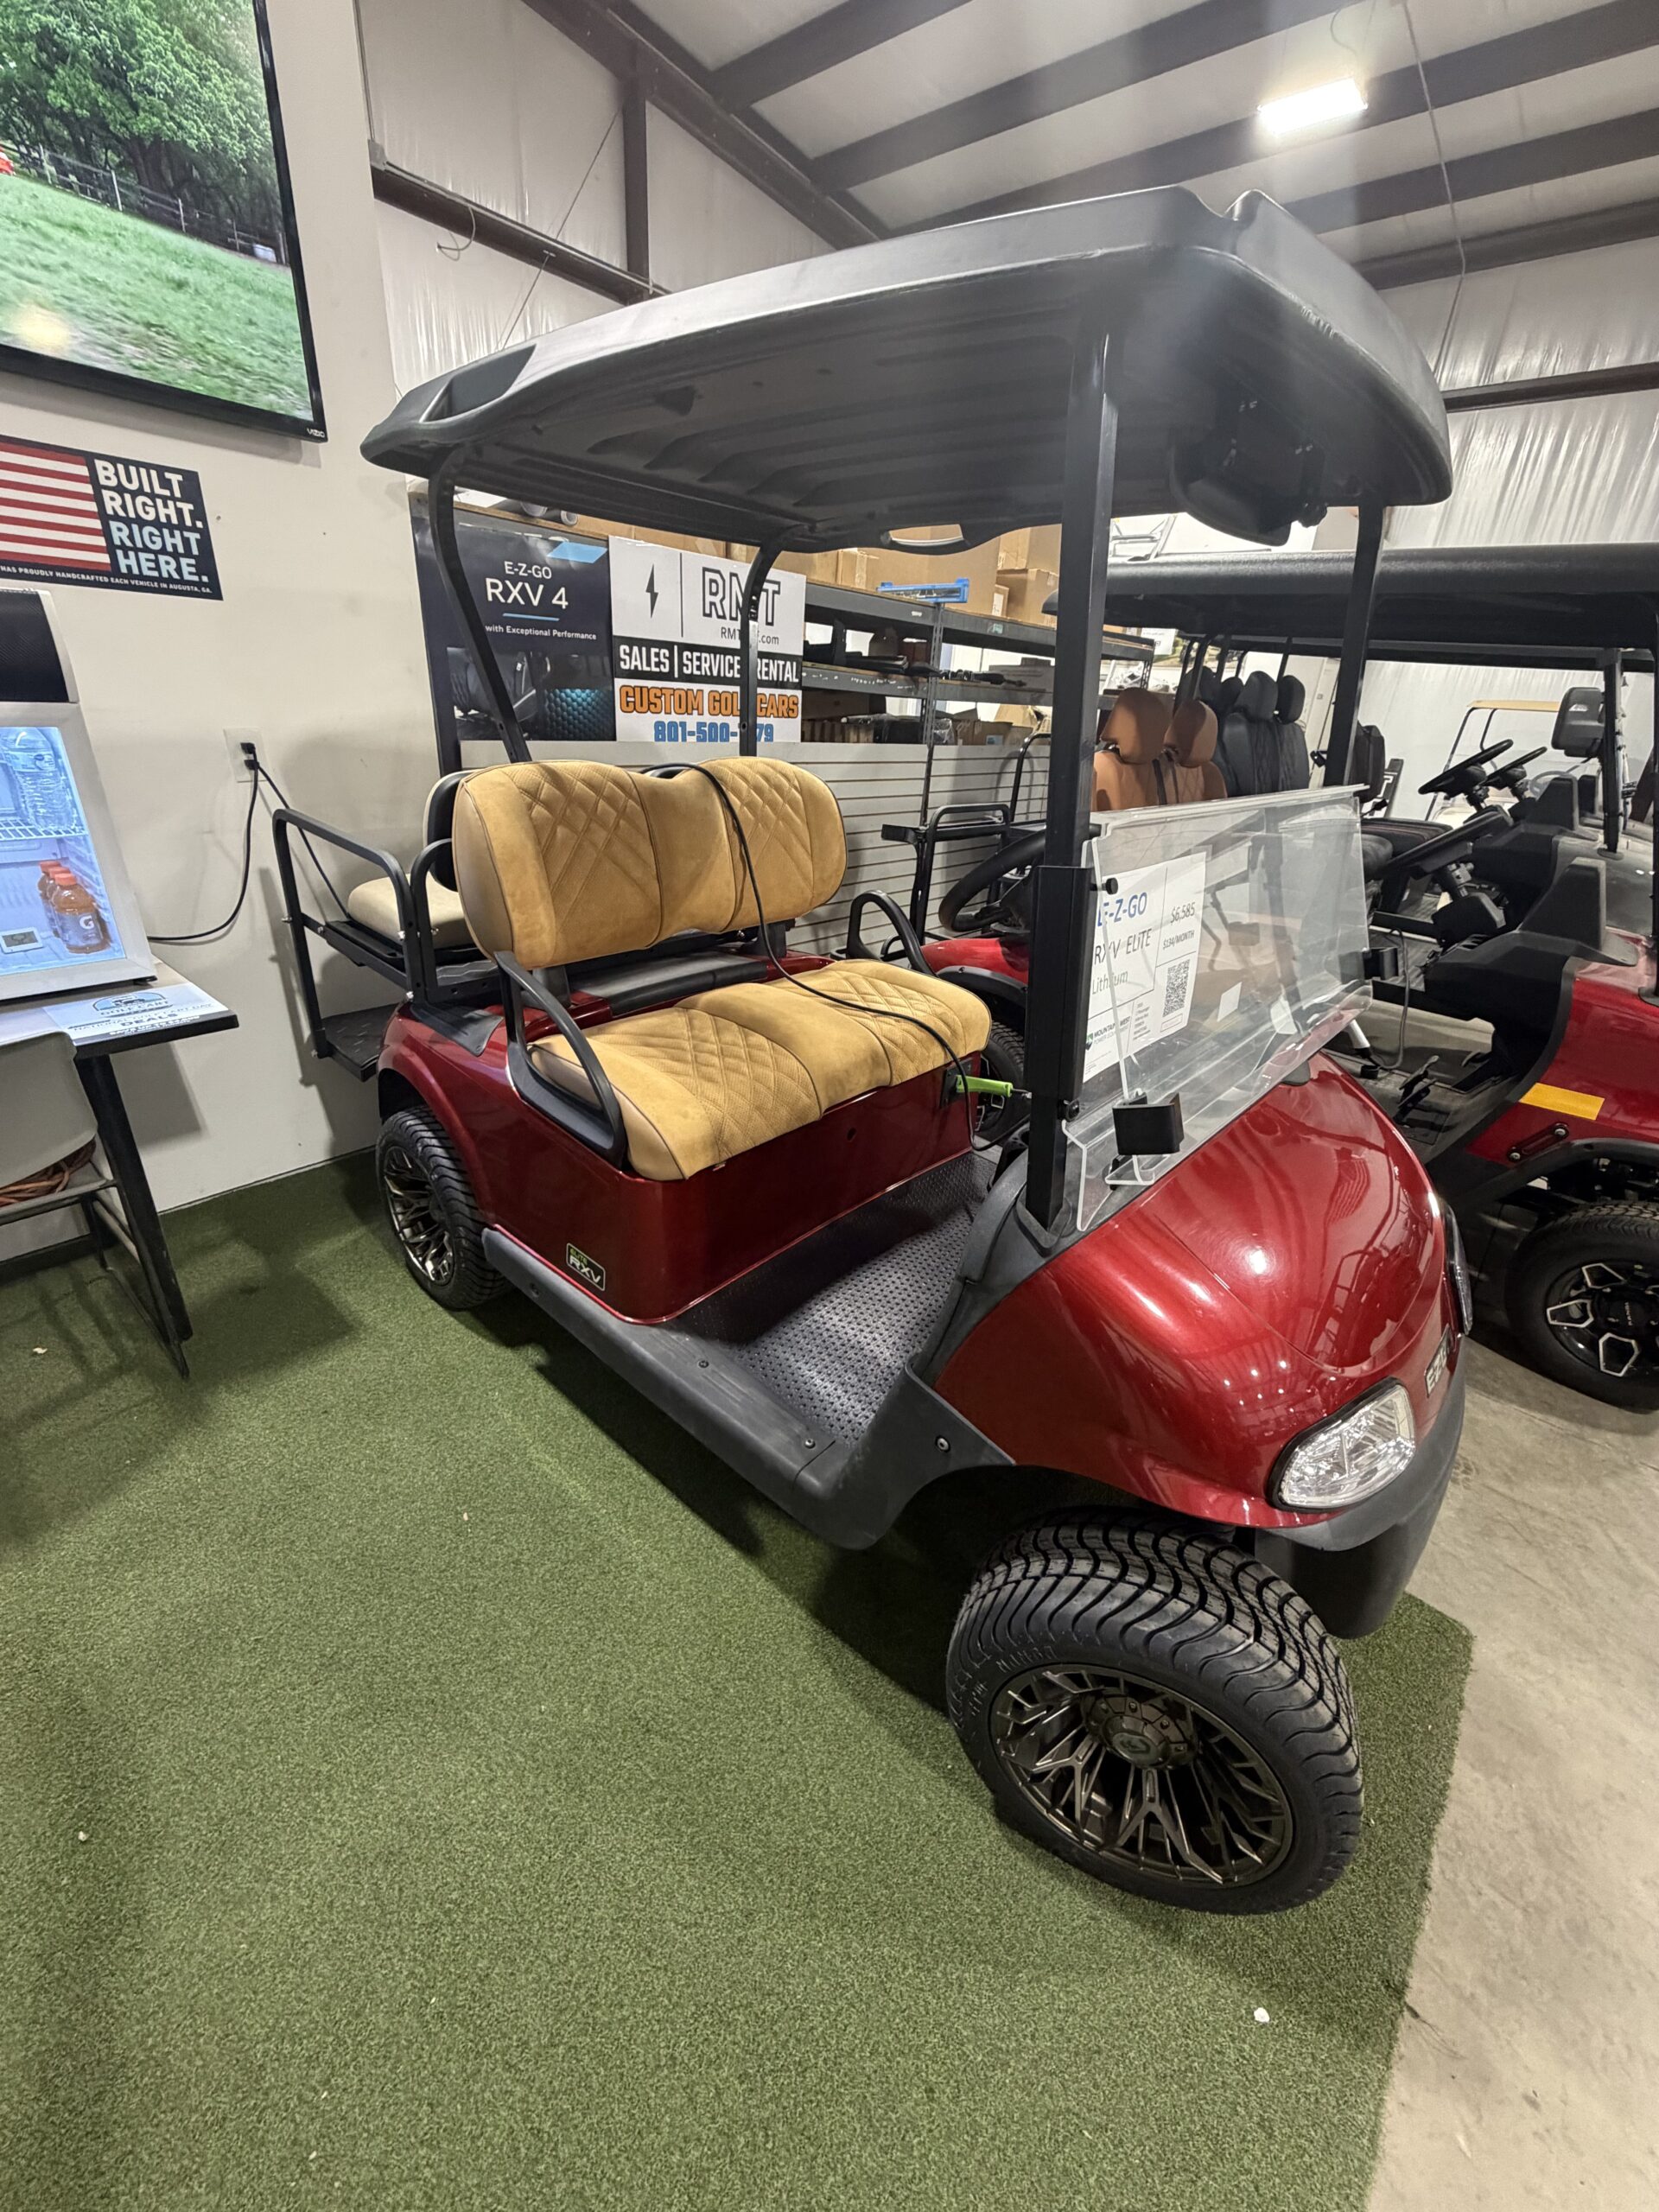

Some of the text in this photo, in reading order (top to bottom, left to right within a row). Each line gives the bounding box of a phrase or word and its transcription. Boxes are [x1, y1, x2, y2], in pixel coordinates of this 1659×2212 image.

[306, 427, 326, 438] VIZIO
[94, 459, 183, 499] BUILT
[101, 488, 204, 529] RIGHT.
[109, 520, 200, 556] RIGHT
[0, 565, 17, 574] HAS
[18, 567, 54, 577] PROUDLY
[55, 571, 109, 583] HANDCRAFTED
[111, 577, 130, 586] EACH
[130, 579, 159, 588] VEHICLE
[169, 583, 200, 593] AUGUSTA,
[115, 549, 209, 582] HERE.
[504, 561, 553, 580] E-Z-GO
[485, 577, 569, 610] RXV 4
[485, 624, 597, 640] with Exceptional Performance
[620, 645, 671, 673] SALES
[682, 651, 741, 678] SERVICE
[620, 684, 799, 719] CUSTOM GOL CARS
[79, 915, 95, 930] G
[1170, 901, 1196, 925] $6,585
[569, 1255, 602, 1283] RXV
